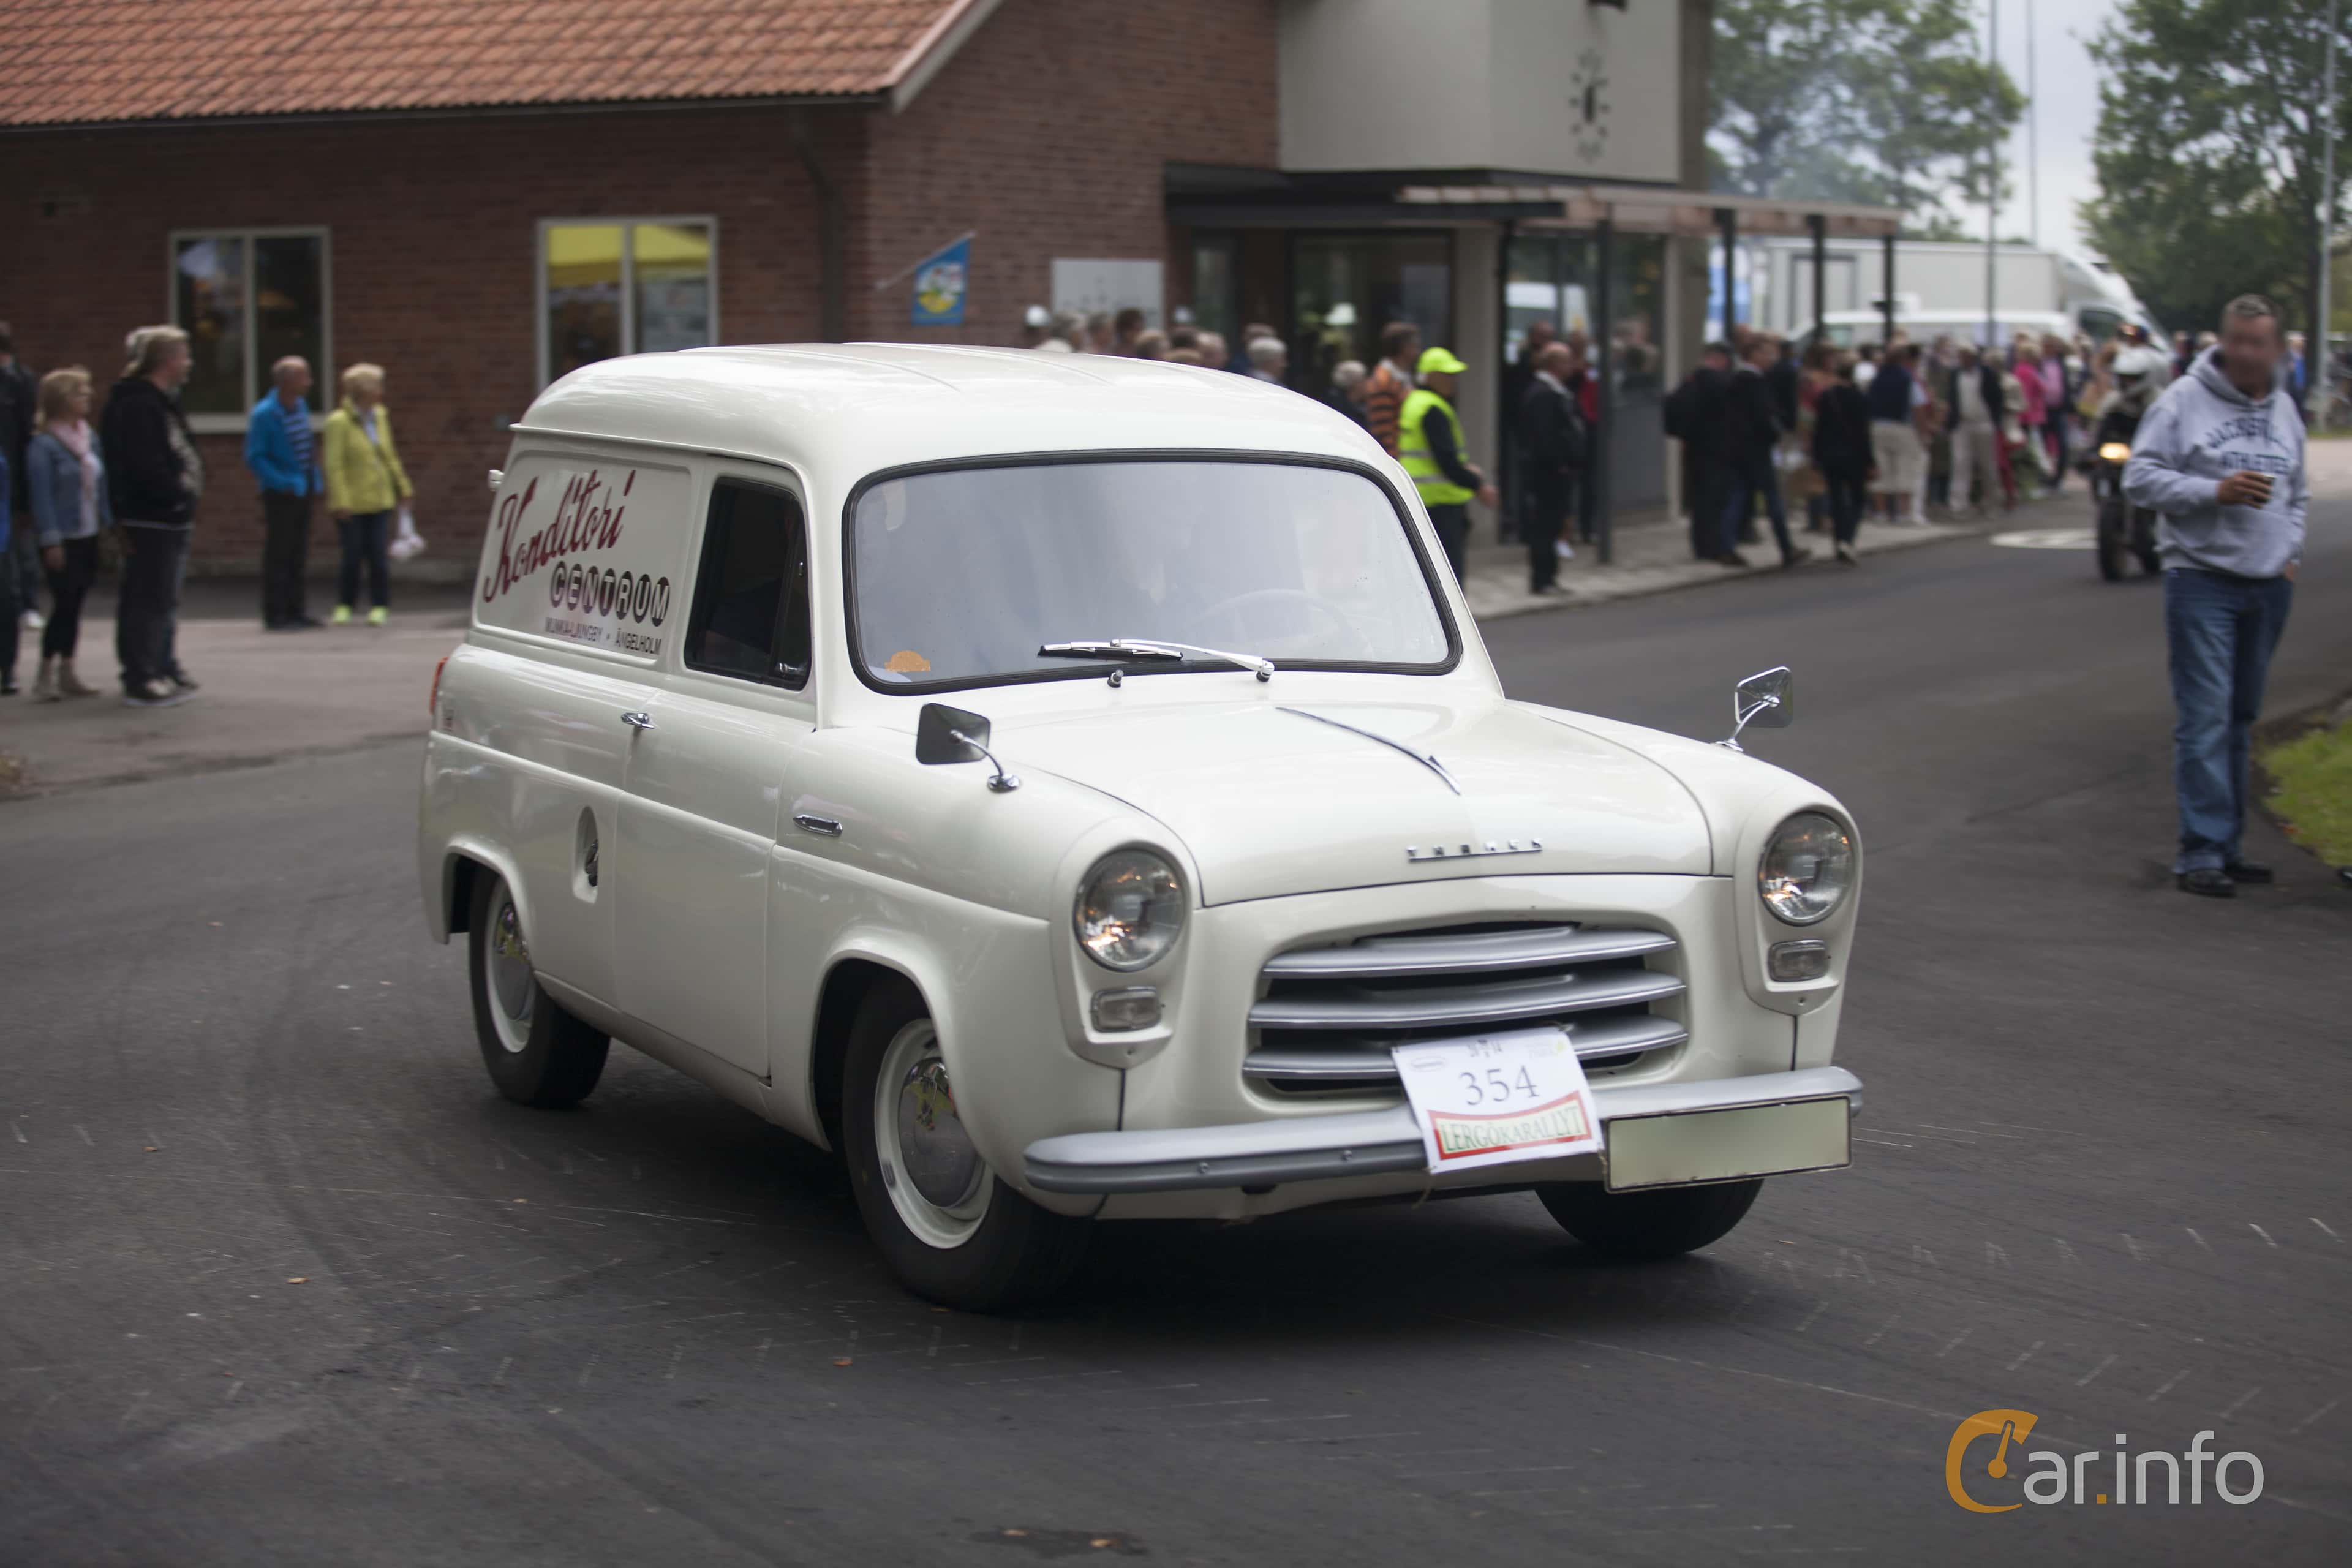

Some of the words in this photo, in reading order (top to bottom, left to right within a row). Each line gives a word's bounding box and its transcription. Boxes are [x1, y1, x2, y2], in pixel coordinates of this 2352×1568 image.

[483, 469, 636, 603] Konditori
[550, 560, 671, 627] CENTRUM
[615, 628, 662, 655] ÄNGELHOLM
[1458, 1064, 1540, 1106] 354
